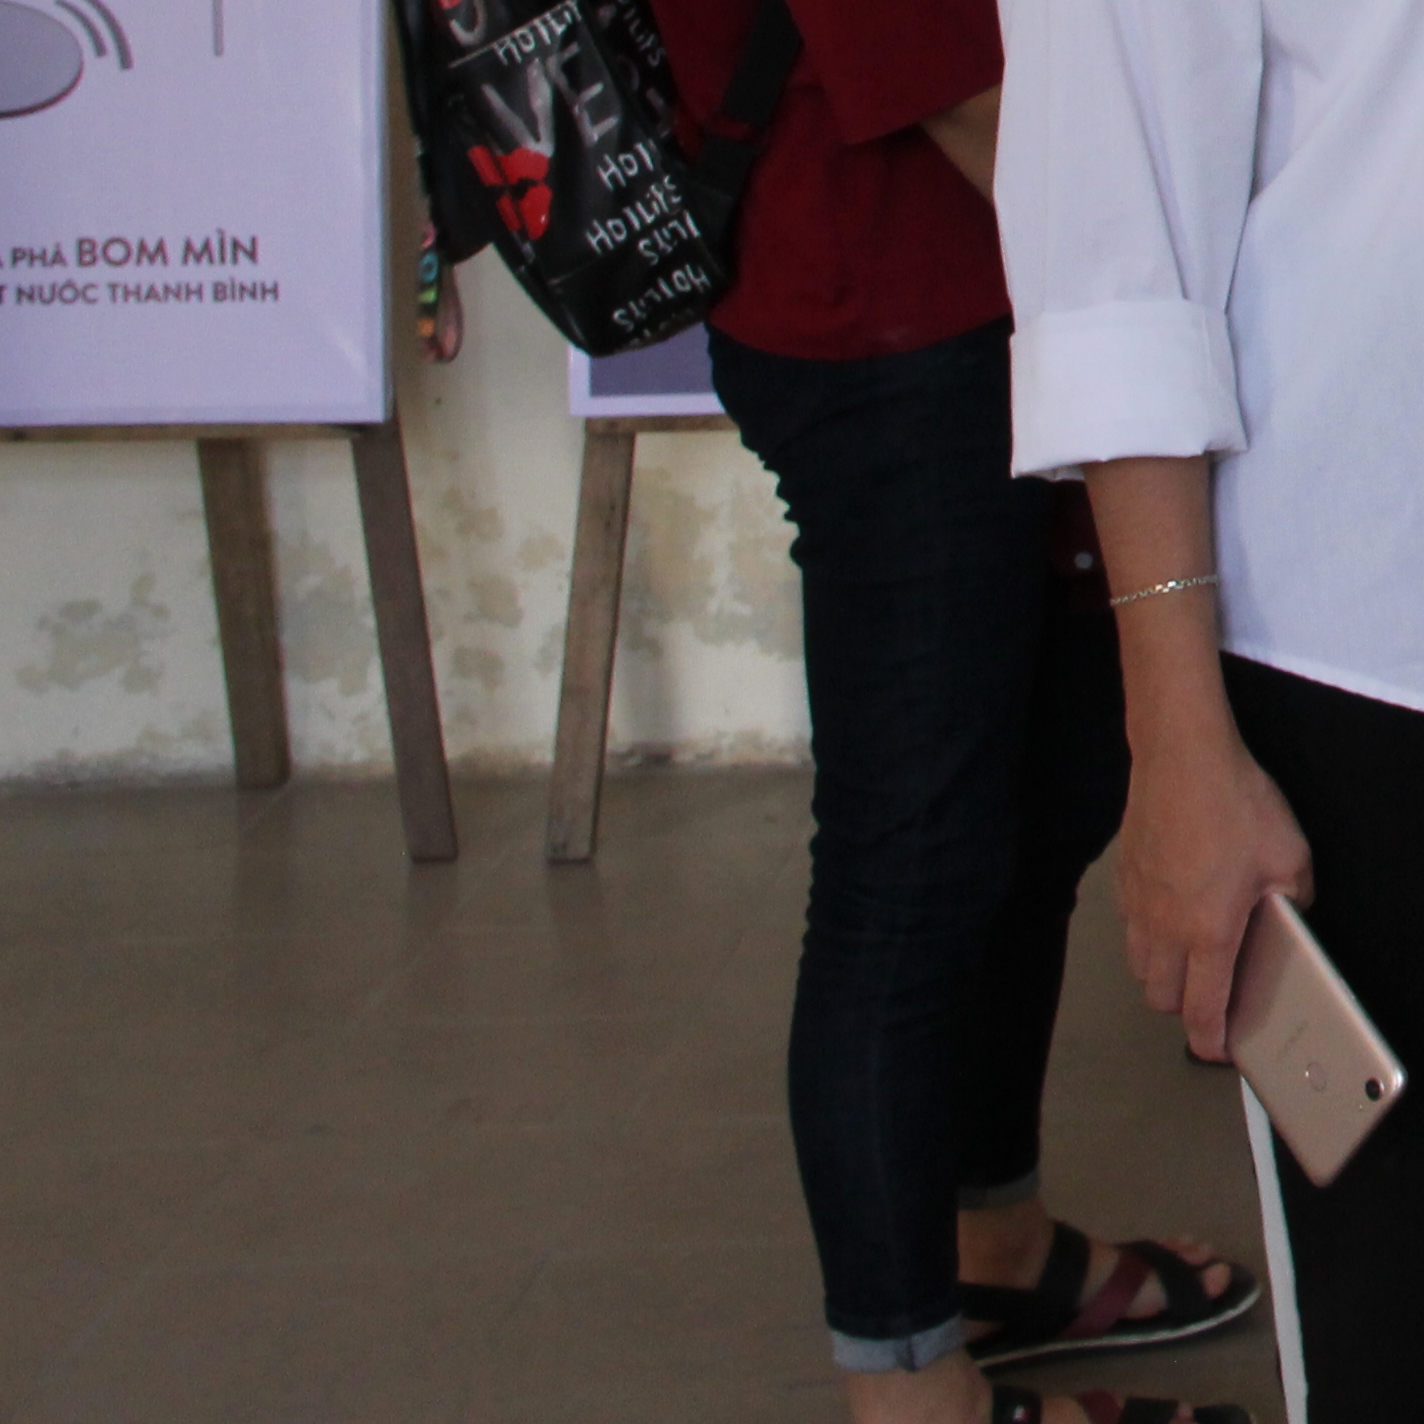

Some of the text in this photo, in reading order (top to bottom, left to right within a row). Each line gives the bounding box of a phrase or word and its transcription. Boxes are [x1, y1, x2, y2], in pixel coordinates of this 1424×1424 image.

[76, 236, 169, 268] BOM
[181, 227, 260, 267] MÌN
[108, 281, 203, 305] THANH
[212, 277, 281, 304] BÌNH
